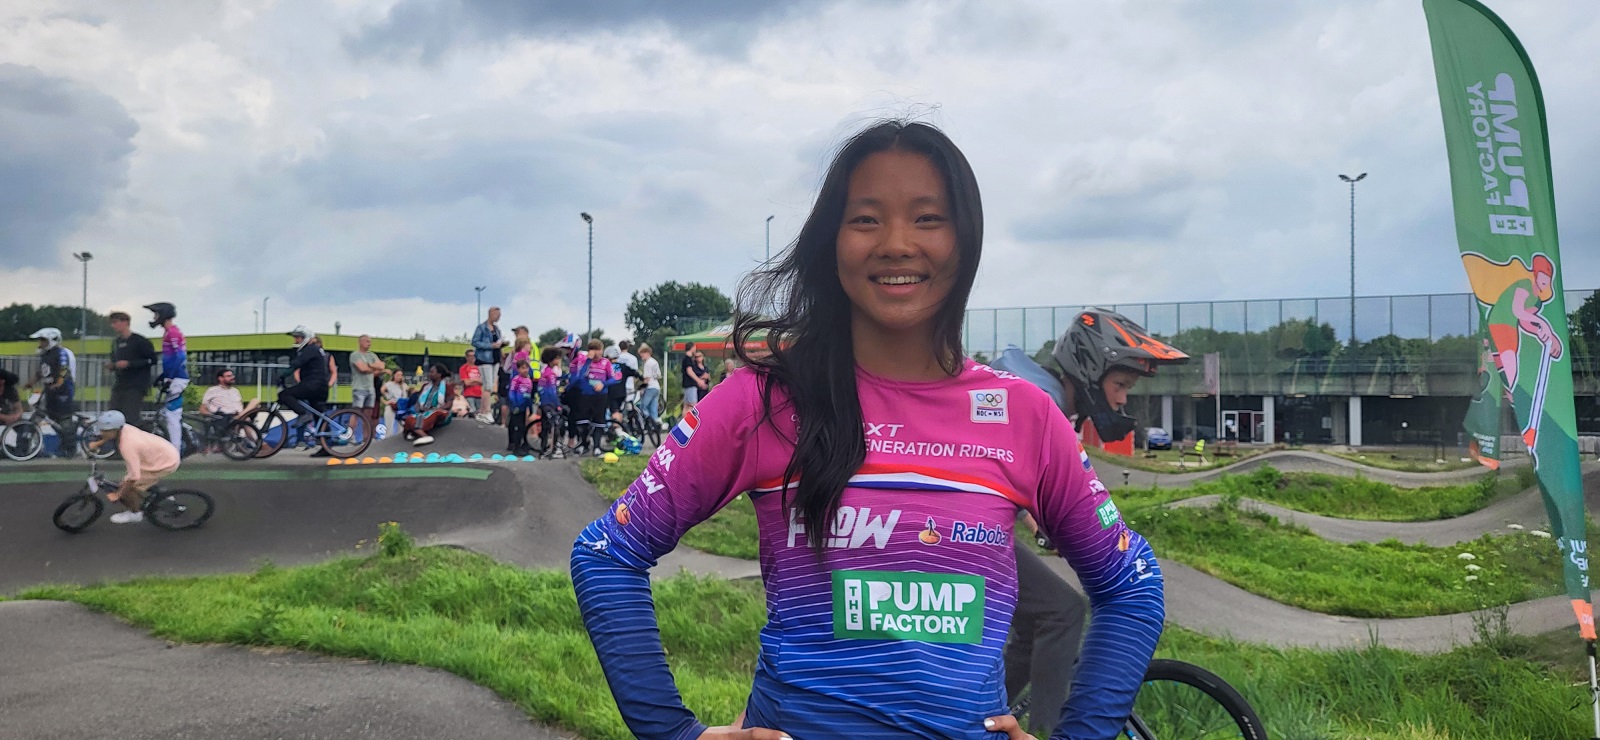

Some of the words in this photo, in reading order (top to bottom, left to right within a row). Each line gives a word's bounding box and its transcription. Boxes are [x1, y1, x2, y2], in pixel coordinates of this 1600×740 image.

[865, 438, 956, 457] ENERATION
[959, 443, 1015, 463] RIDERS
[849, 586, 859, 624] THE
[865, 581, 976, 612] PUMP
[870, 613, 969, 635] FACTORY
